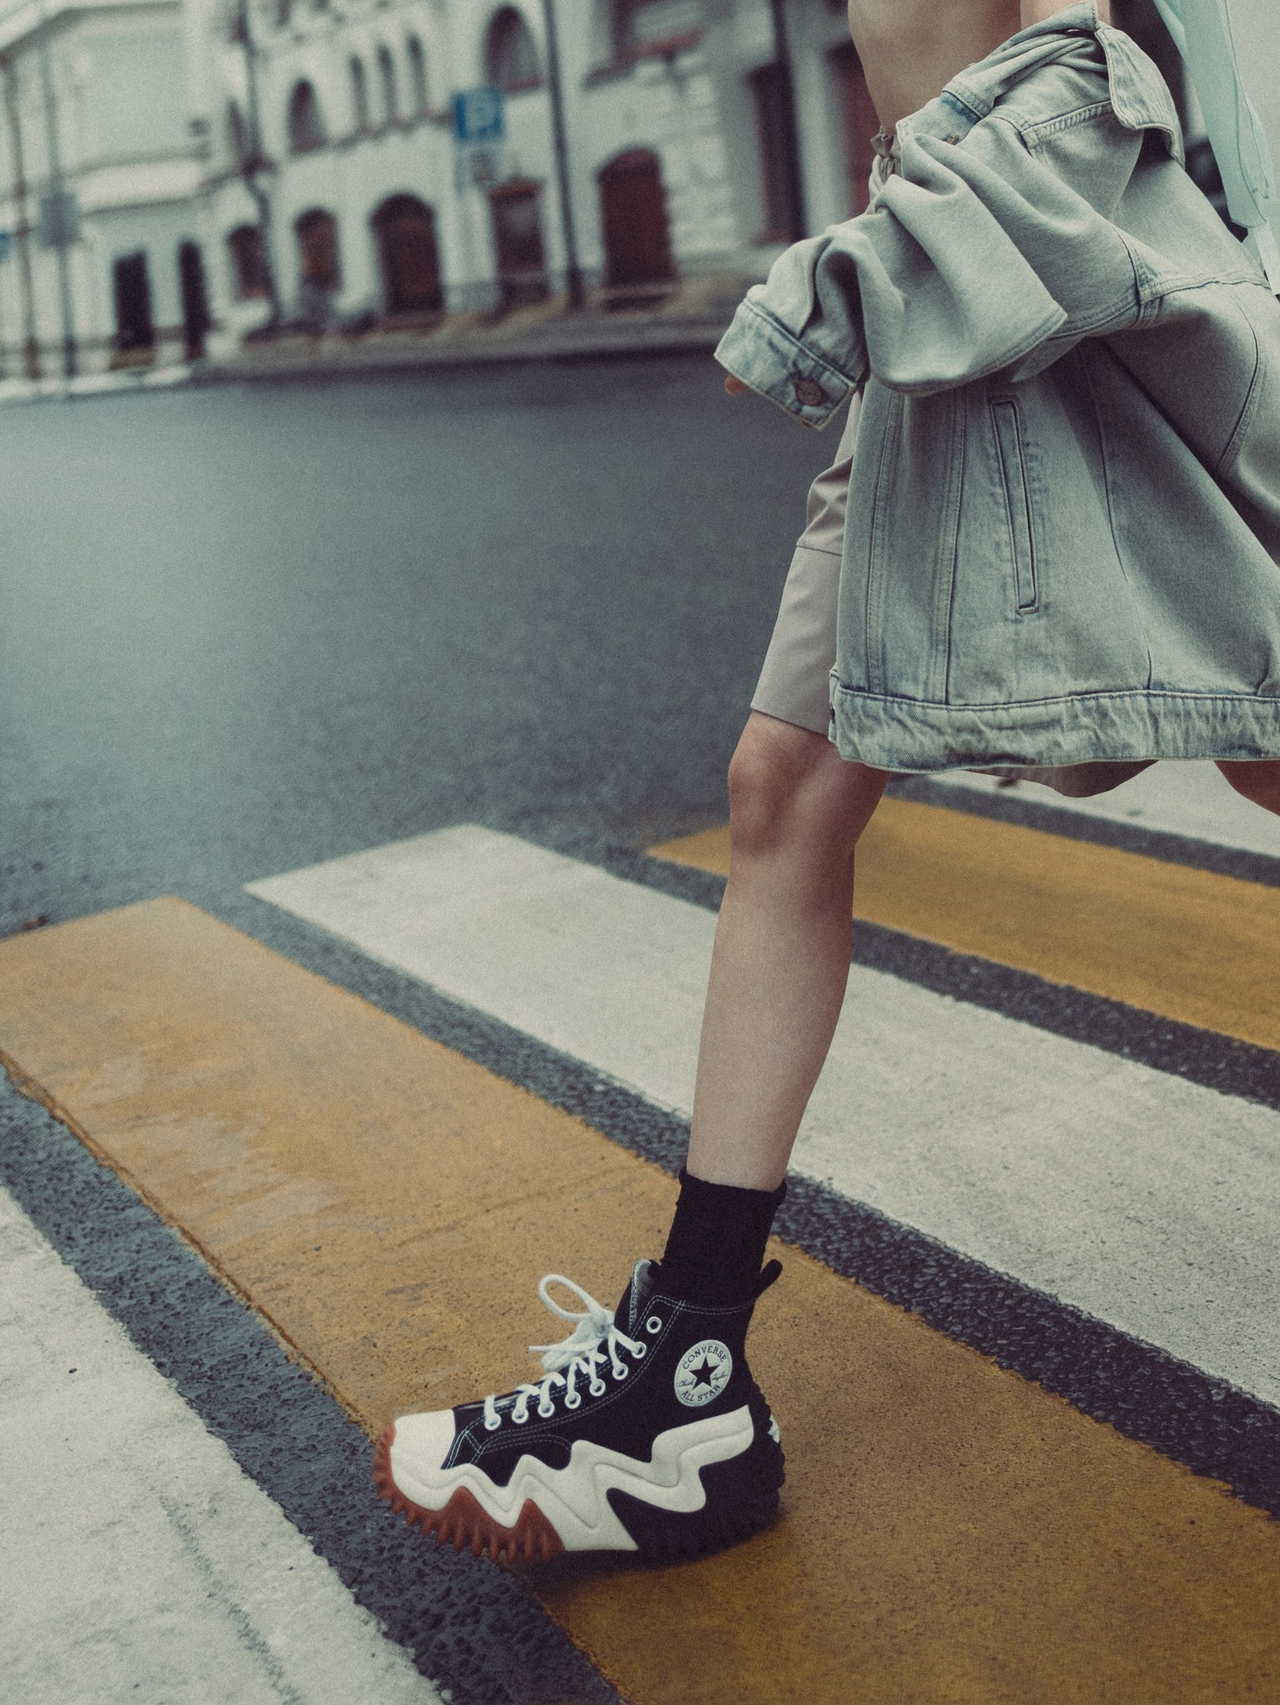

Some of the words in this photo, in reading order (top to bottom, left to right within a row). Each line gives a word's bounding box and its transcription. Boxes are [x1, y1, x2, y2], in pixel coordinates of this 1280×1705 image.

[682, 1345, 727, 1369] CONVERSE
[681, 1390, 695, 1402] ALL
[697, 1385, 721, 1402] STAR
